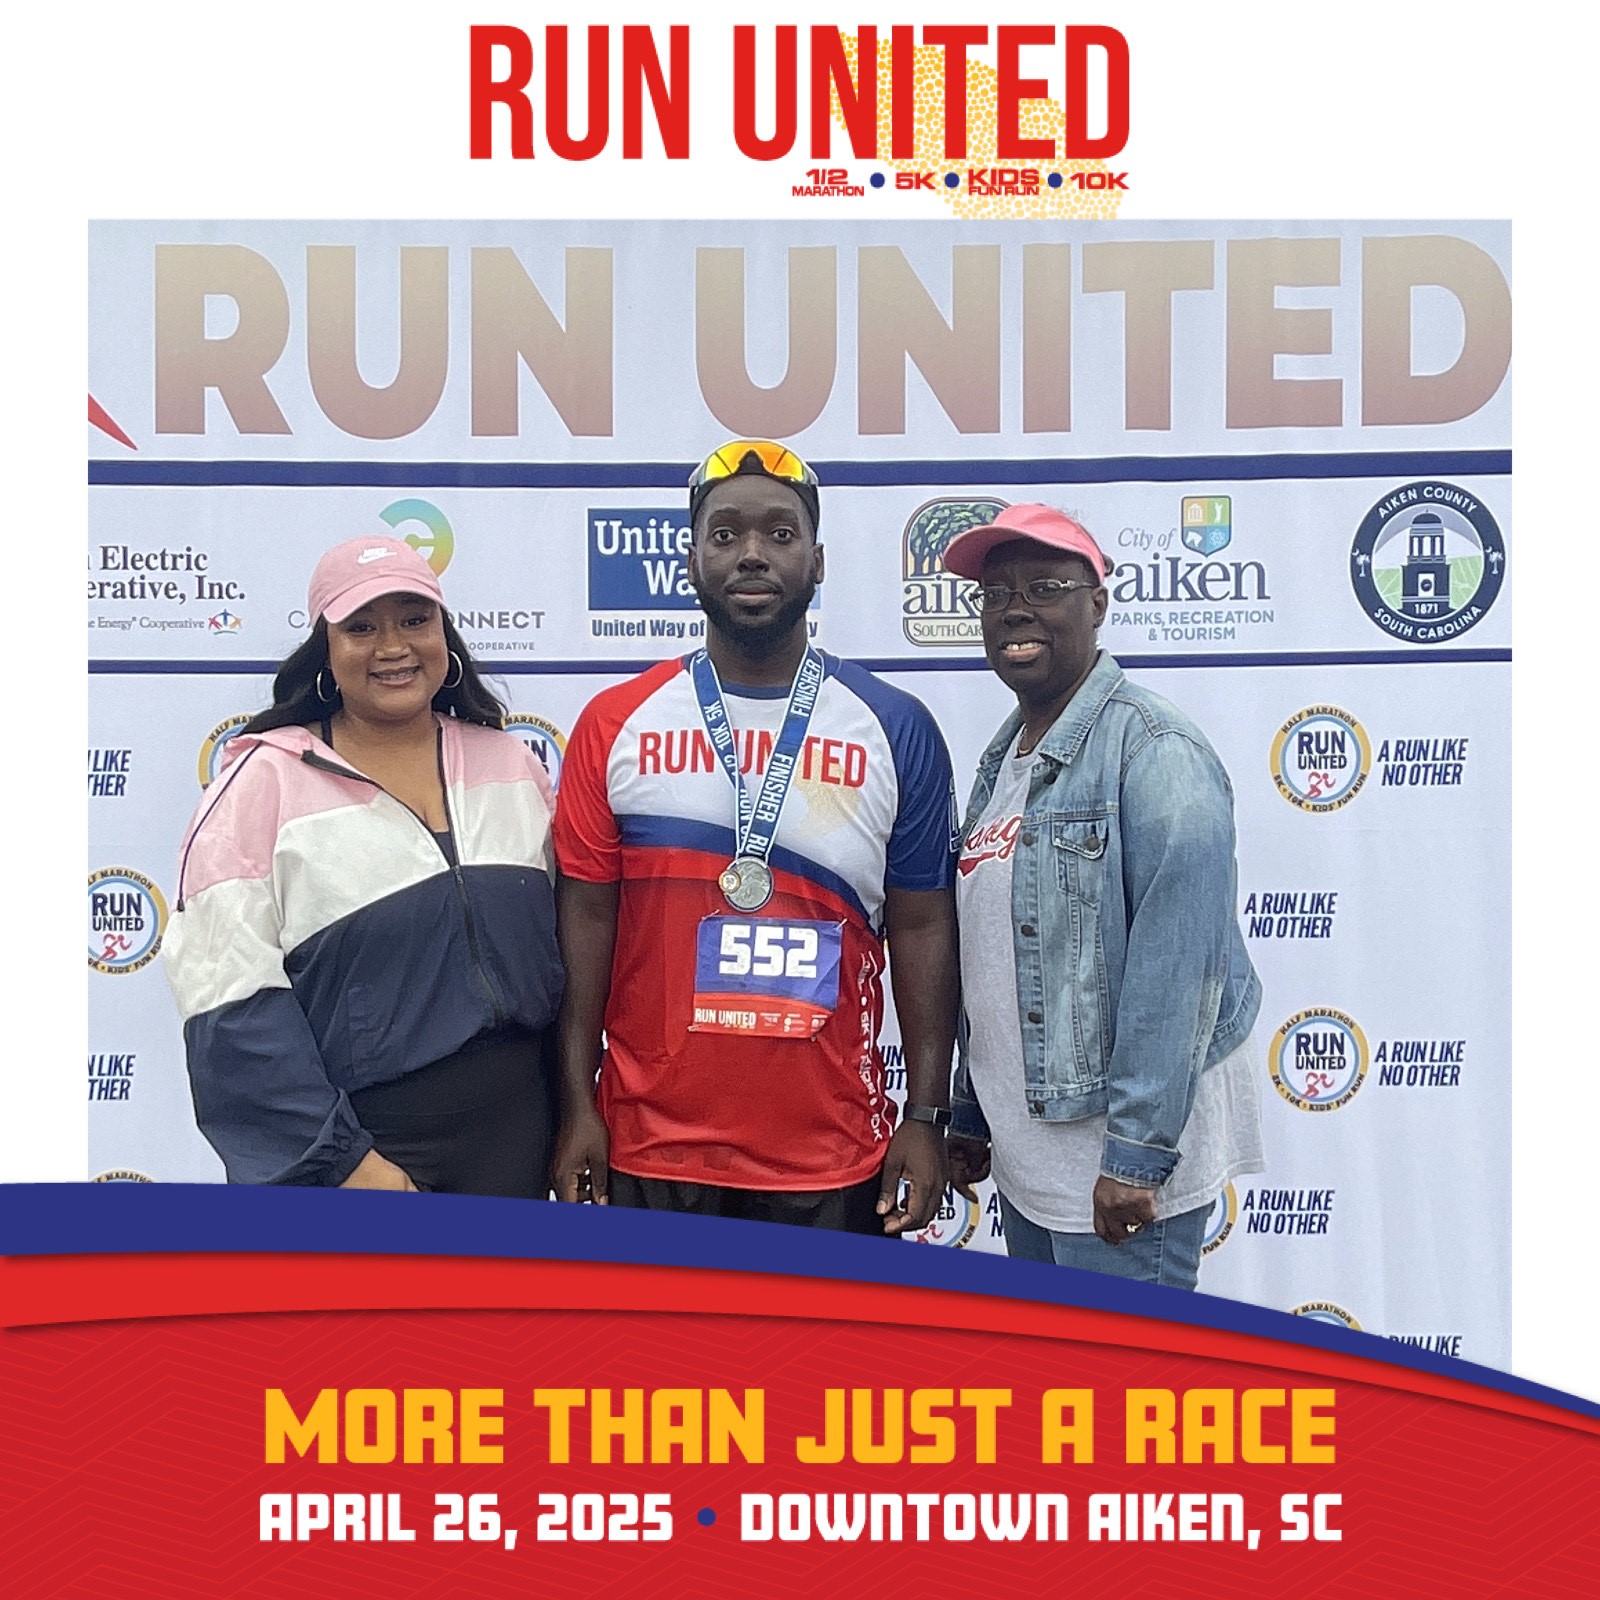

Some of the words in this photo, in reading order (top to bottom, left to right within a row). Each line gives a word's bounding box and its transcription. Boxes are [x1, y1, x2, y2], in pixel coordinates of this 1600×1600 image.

[155, 244, 613, 439] RUN
[696, 235, 1512, 438] UNITED
[1378, 488, 1418, 518] AIKEN
[1423, 486, 1477, 513] COUNTY
[1118, 527, 1153, 550] City
[1157, 528, 1176, 550] of
[99, 545, 208, 571] Electric
[195, 575, 245, 600] Inc.
[643, 560, 700, 604] Wa
[1112, 552, 1271, 602] aiken
[1111, 612, 1165, 627] PARKS,
[1169, 610, 1274, 625] RECREATION
[1414, 603, 1438, 615] 1871
[139, 617, 204, 630] Cooperative
[592, 619, 645, 636] United
[650, 619, 685, 638] Way
[689, 619, 705, 637] of
[913, 623, 956, 637] SOUTH
[1374, 608, 1413, 637] SOUTH
[1417, 605, 1482, 639] CAROLINA
[1148, 628, 1157, 641] &
[1162, 627, 1235, 641] TOURISM
[464, 641, 535, 651] OOPERATIVE
[790, 658, 821, 718] FINISHER
[703, 700, 722, 722] 5K
[1281, 712, 1303, 734] HALF
[1306, 707, 1357, 728] MARATHON
[504, 715, 559, 737] MARATHON
[711, 722, 732, 750] 10K
[1298, 731, 1345, 755] RUN
[1377, 740, 1390, 762] A
[1394, 739, 1430, 762] RUN
[1431, 739, 1468, 762] LIKE
[92, 749, 132, 772] LIKE
[638, 729, 714, 775] RUN
[734, 728, 867, 787] UNTED
[1298, 755, 1347, 770] UNITED
[1352, 773, 1367, 792] RUN
[1381, 764, 1408, 786] NO
[1409, 764, 1463, 786] OTHER
[756, 753, 794, 823] FINISHER
[100, 869, 153, 890] MARATHON
[92, 893, 142, 916] RUN
[1244, 893, 1257, 915] A
[1260, 893, 1298, 915] RUN
[1300, 893, 1338, 915] LIKE
[92, 917, 144, 932] UNITED
[1248, 917, 1275, 939] NO
[1276, 917, 1333, 939] OTHER
[719, 925, 819, 978] 552
[694, 1008, 717, 1024] RUN
[718, 1010, 757, 1026] UNITED
[1304, 1008, 1355, 1030] MARATHON
[1295, 1032, 1345, 1056] RUN
[1374, 1041, 1387, 1063] A
[1391, 1041, 1428, 1063] RUN
[1429, 1040, 1465, 1063] LIKE
[97, 1054, 136, 1076] LIKE
[1295, 1056, 1347, 1070] UNITED
[1378, 1065, 1405, 1087] NO
[1406, 1065, 1460, 1086] OTHER
[986, 1193, 999, 1215] A
[1243, 1189, 1255, 1212] A
[1258, 1189, 1295, 1212] RUN
[1297, 1189, 1336, 1212] LIKE
[1218, 1221, 1233, 1242] RUN
[1246, 1212, 1272, 1234] NO
[1273, 1212, 1330, 1235] OTHER
[1301, 1303, 1352, 1324] MARATHON
